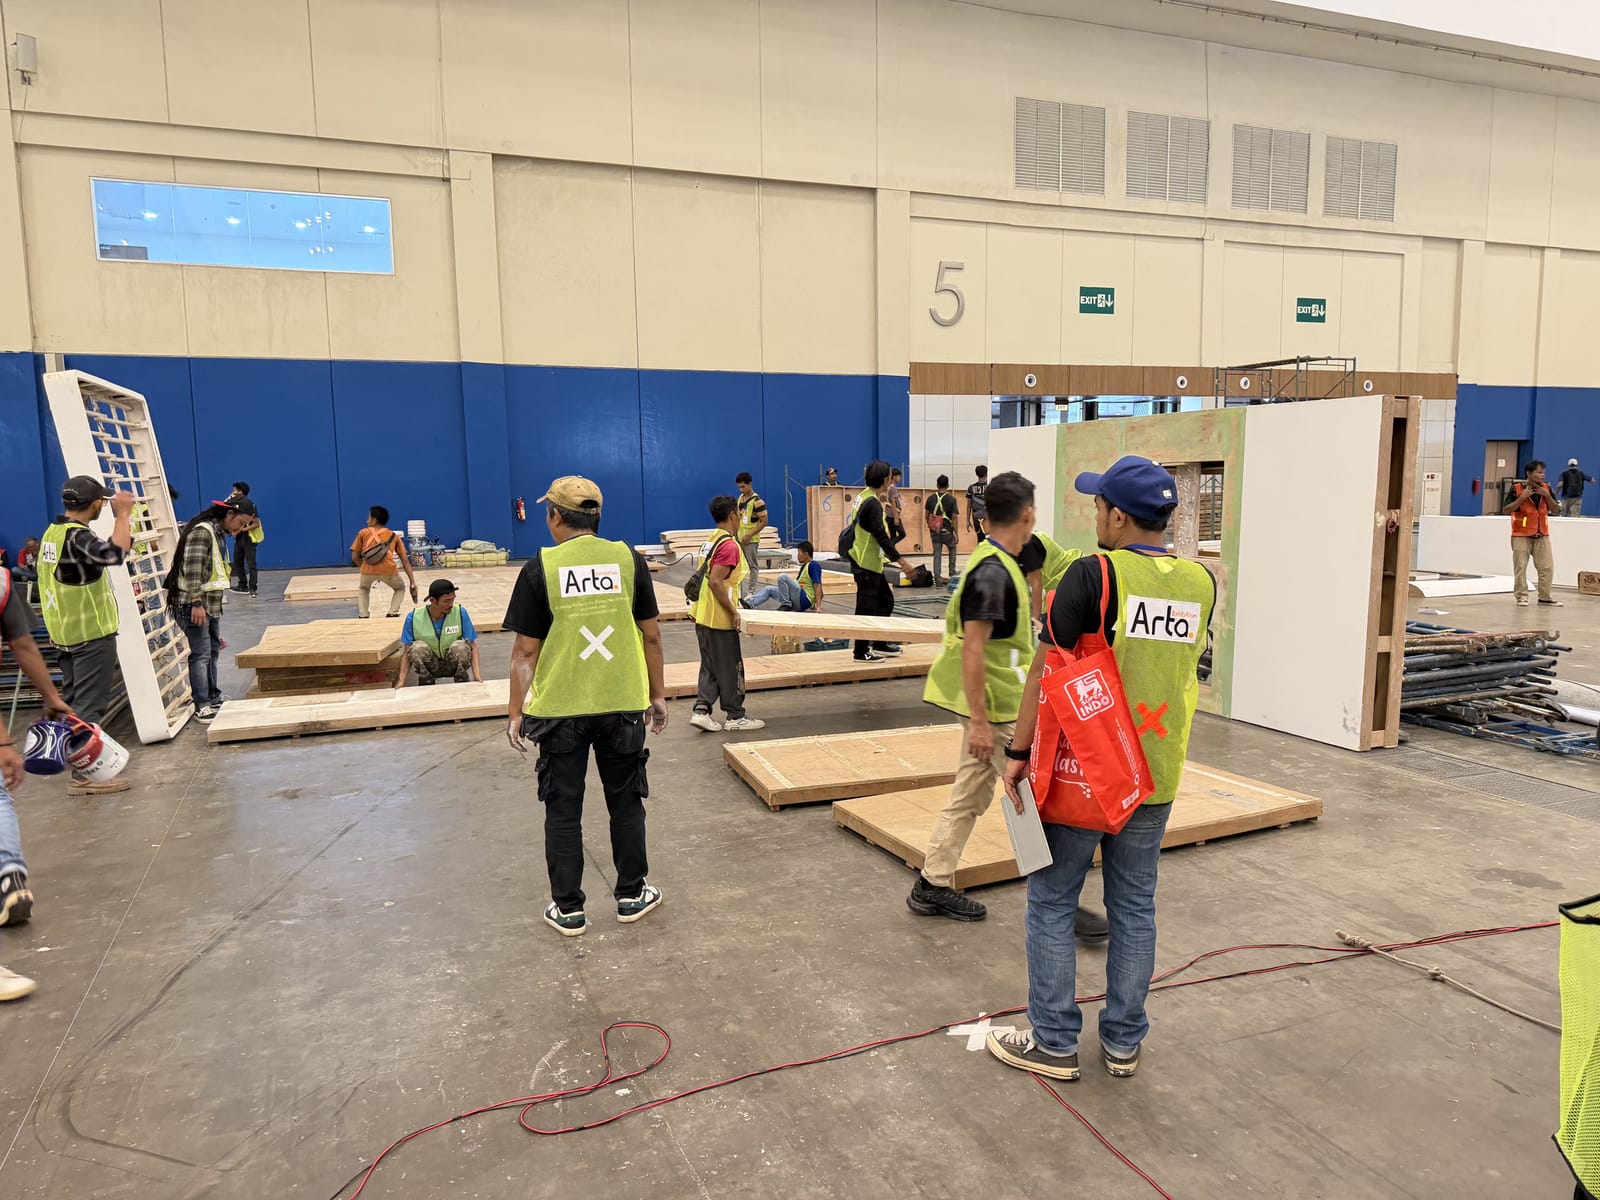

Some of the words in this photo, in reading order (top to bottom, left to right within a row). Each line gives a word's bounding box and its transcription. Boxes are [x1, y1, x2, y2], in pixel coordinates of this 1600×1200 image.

[929, 260, 965, 327] 5
[1080, 296, 1097, 304] EXIT
[1297, 306, 1311, 314] EXIT
[822, 494, 833, 512] 6
[1080, 696, 1110, 717] INDO
